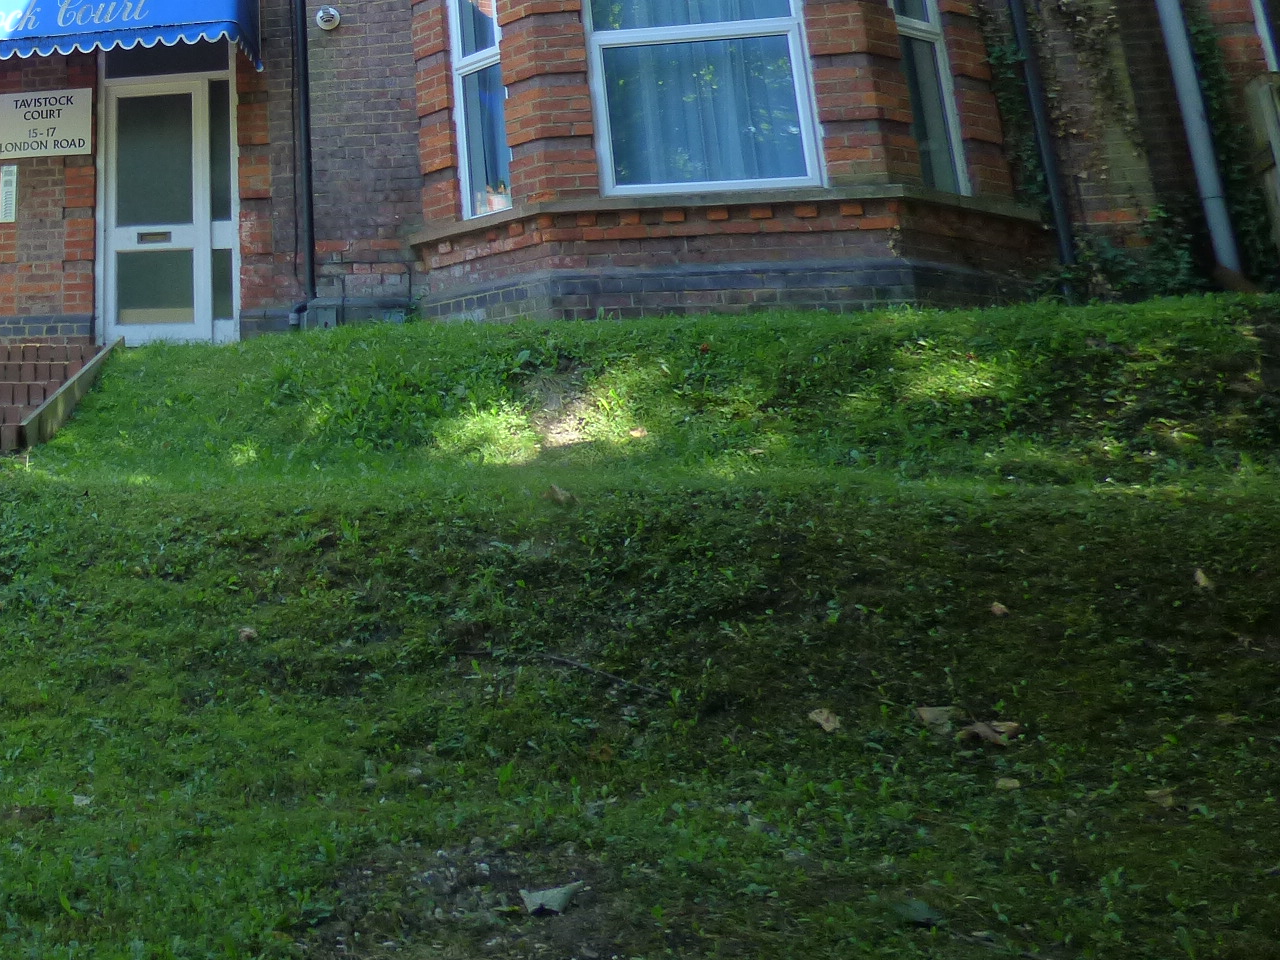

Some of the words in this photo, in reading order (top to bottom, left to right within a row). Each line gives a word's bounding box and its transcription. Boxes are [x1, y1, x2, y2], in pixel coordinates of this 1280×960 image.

[13, 95, 74, 110] TAVISTOCK
[23, 108, 63, 121] COURT
[0, 140, 48, 154] LONDON
[53, 138, 86, 150] ROAD
